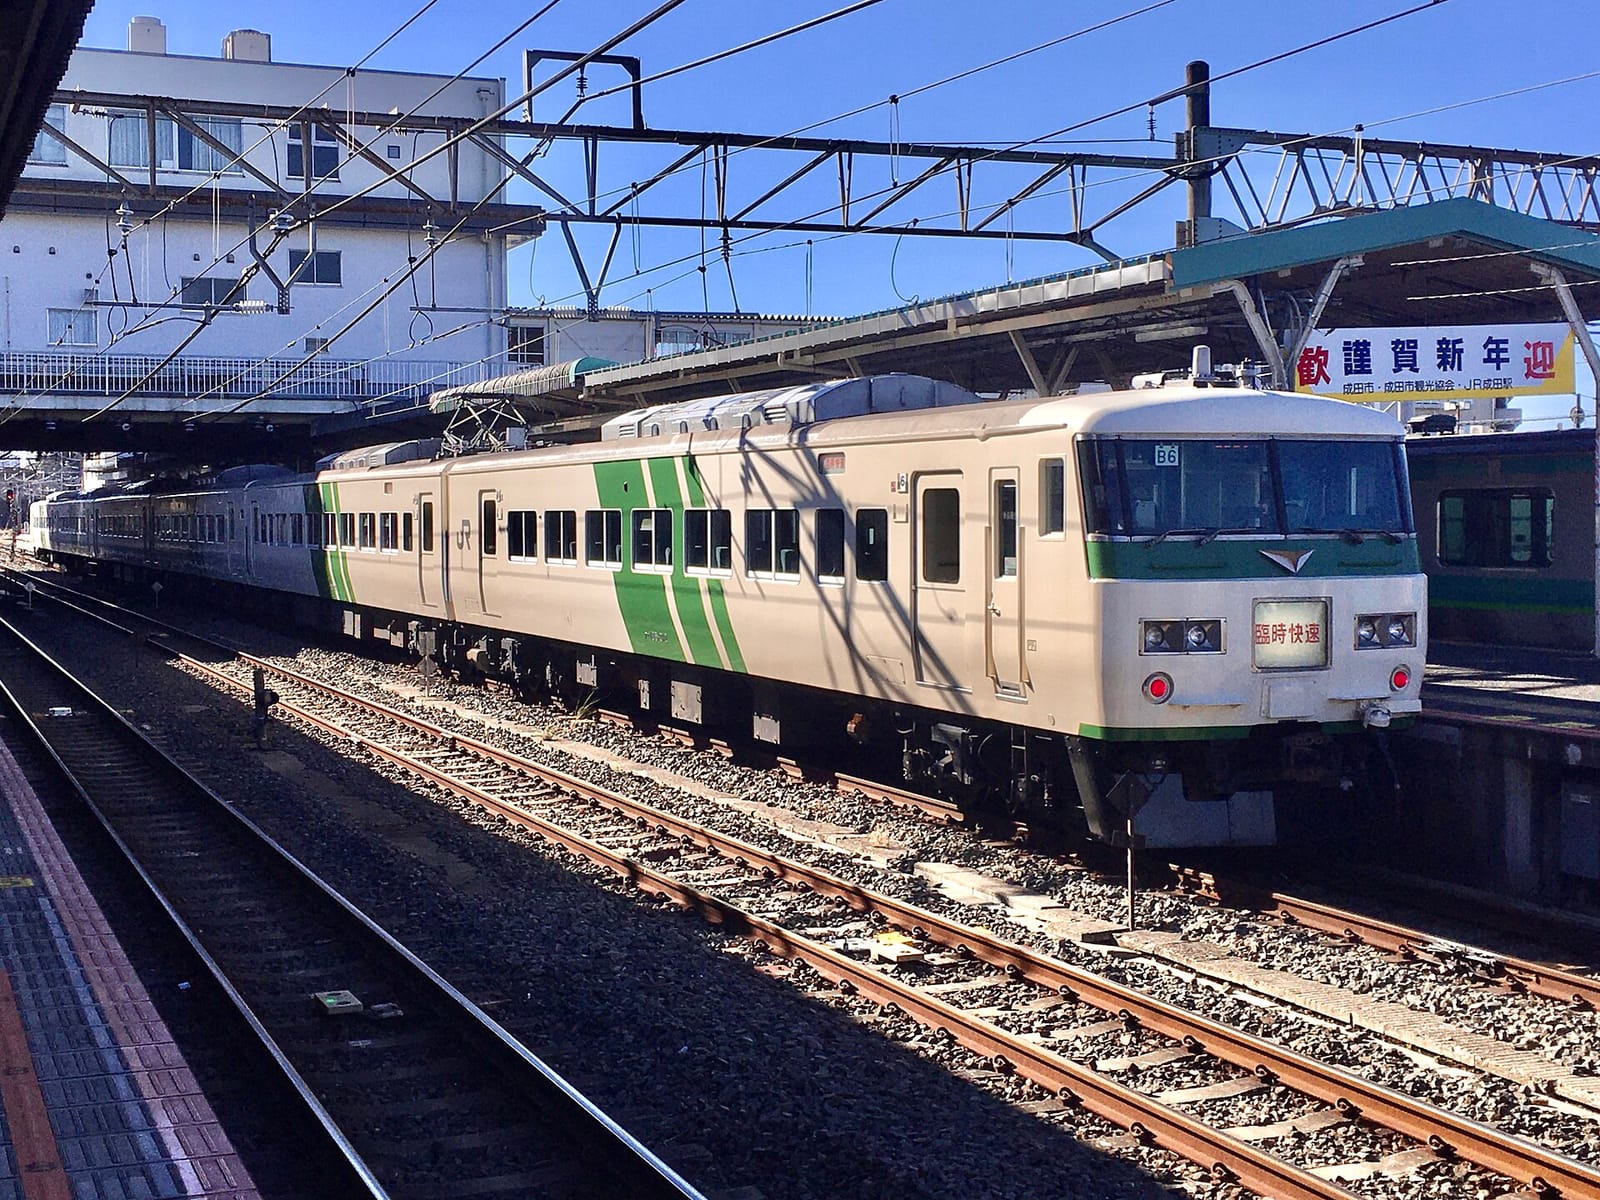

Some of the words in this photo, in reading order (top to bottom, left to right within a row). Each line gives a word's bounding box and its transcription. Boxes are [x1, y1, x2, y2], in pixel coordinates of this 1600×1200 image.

[1157, 450, 1177, 464] B6
[900, 475, 906, 487] 6
[456, 519, 471, 551] JR
[1255, 623, 1321, 645] 臨時快速
